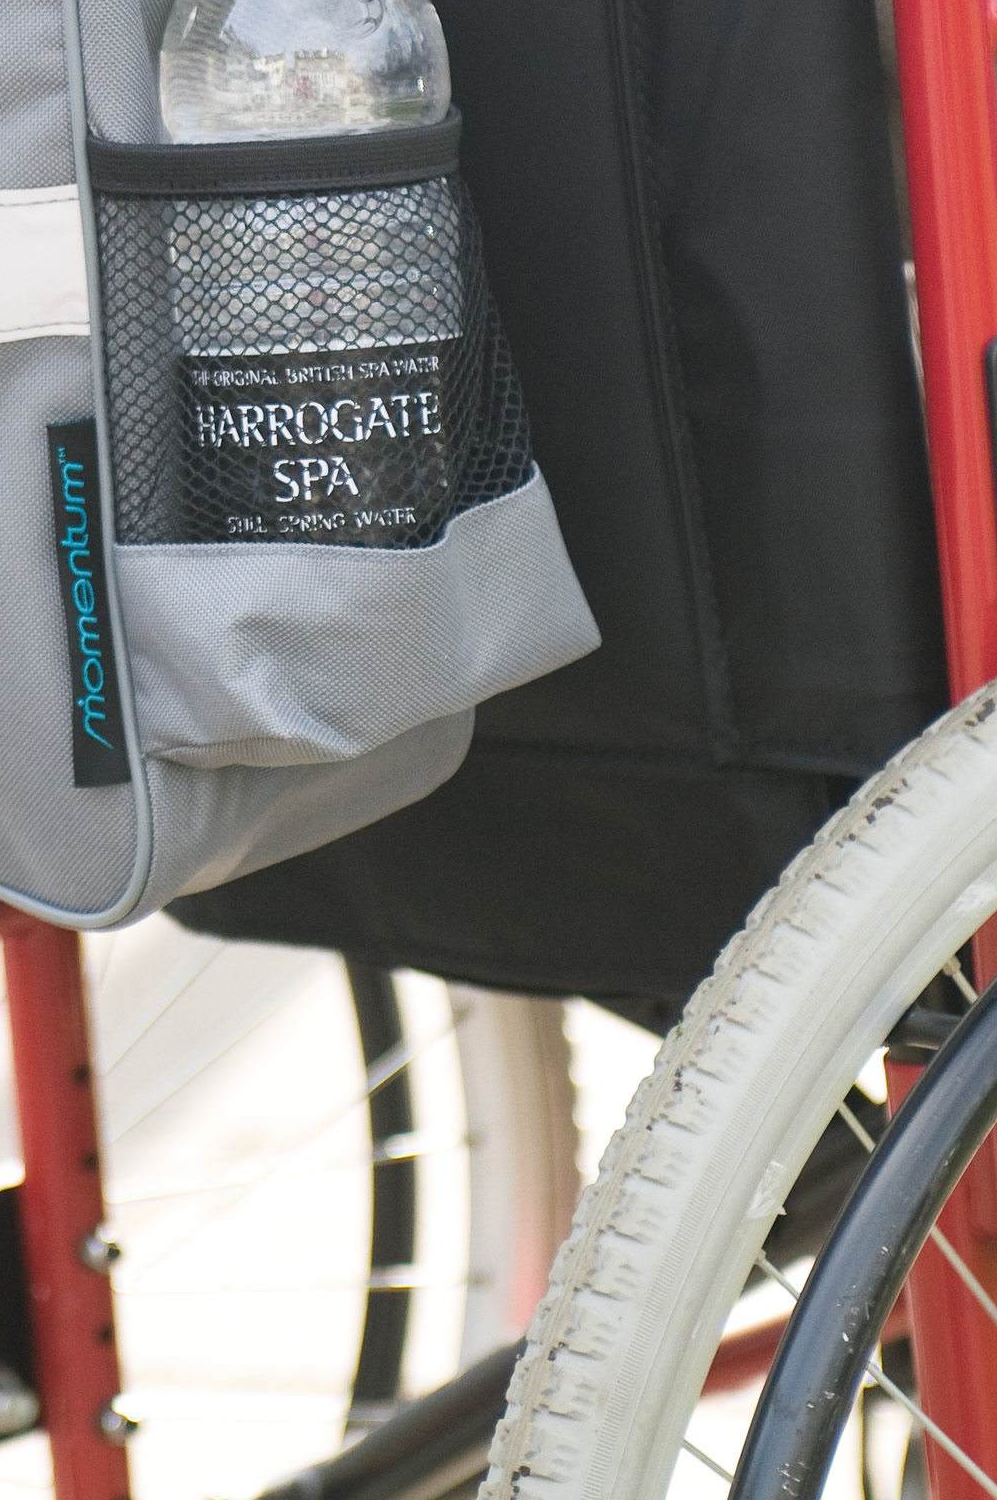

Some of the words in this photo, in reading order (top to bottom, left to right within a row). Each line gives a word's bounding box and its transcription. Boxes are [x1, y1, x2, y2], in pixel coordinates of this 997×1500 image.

[213, 367, 279, 387] ORIGINAL
[286, 364, 353, 385] BRITISH
[359, 361, 390, 379] SPA
[393, 356, 439, 376] WATER
[197, 392, 441, 448] HARROGATE
[273, 456, 361, 503] SPA
[279, 513, 346, 534] SPRING
[354, 507, 416, 528] WATER
